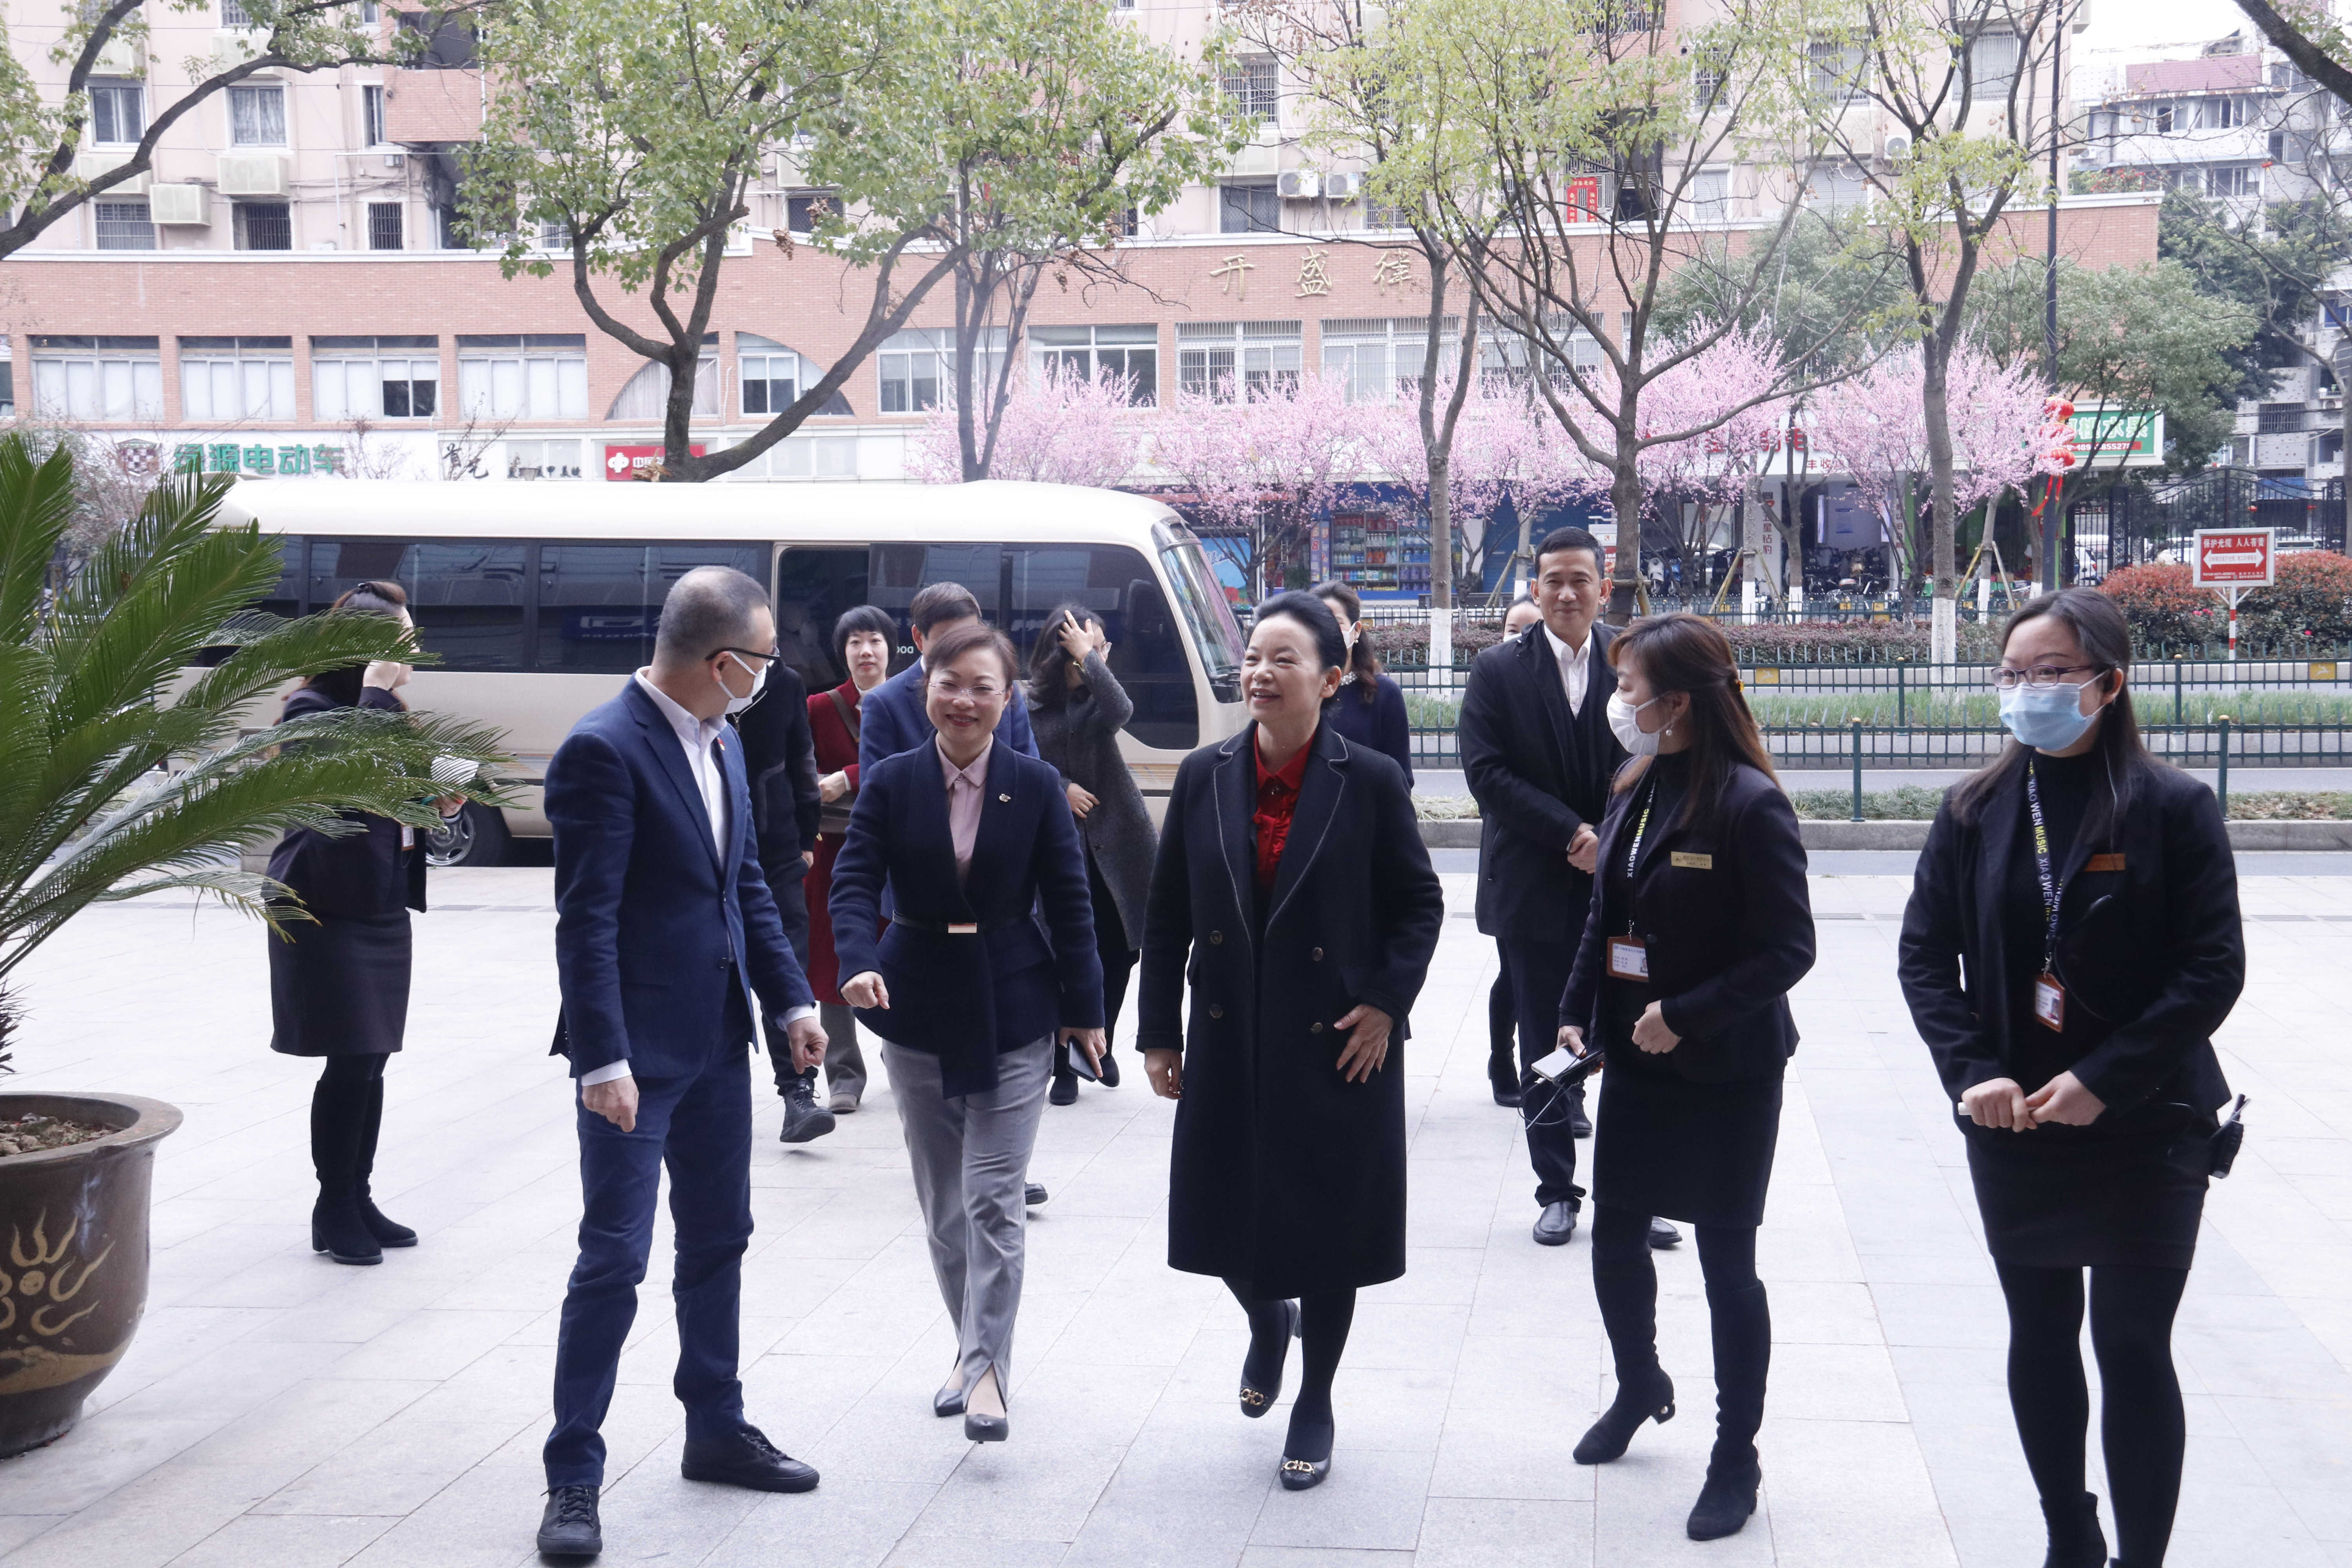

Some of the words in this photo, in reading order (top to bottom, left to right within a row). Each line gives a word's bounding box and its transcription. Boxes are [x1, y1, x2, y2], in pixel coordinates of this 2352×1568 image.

[174, 443, 344, 474] 绿源电动车
[2203, 538, 2232, 548] 保护光缆
